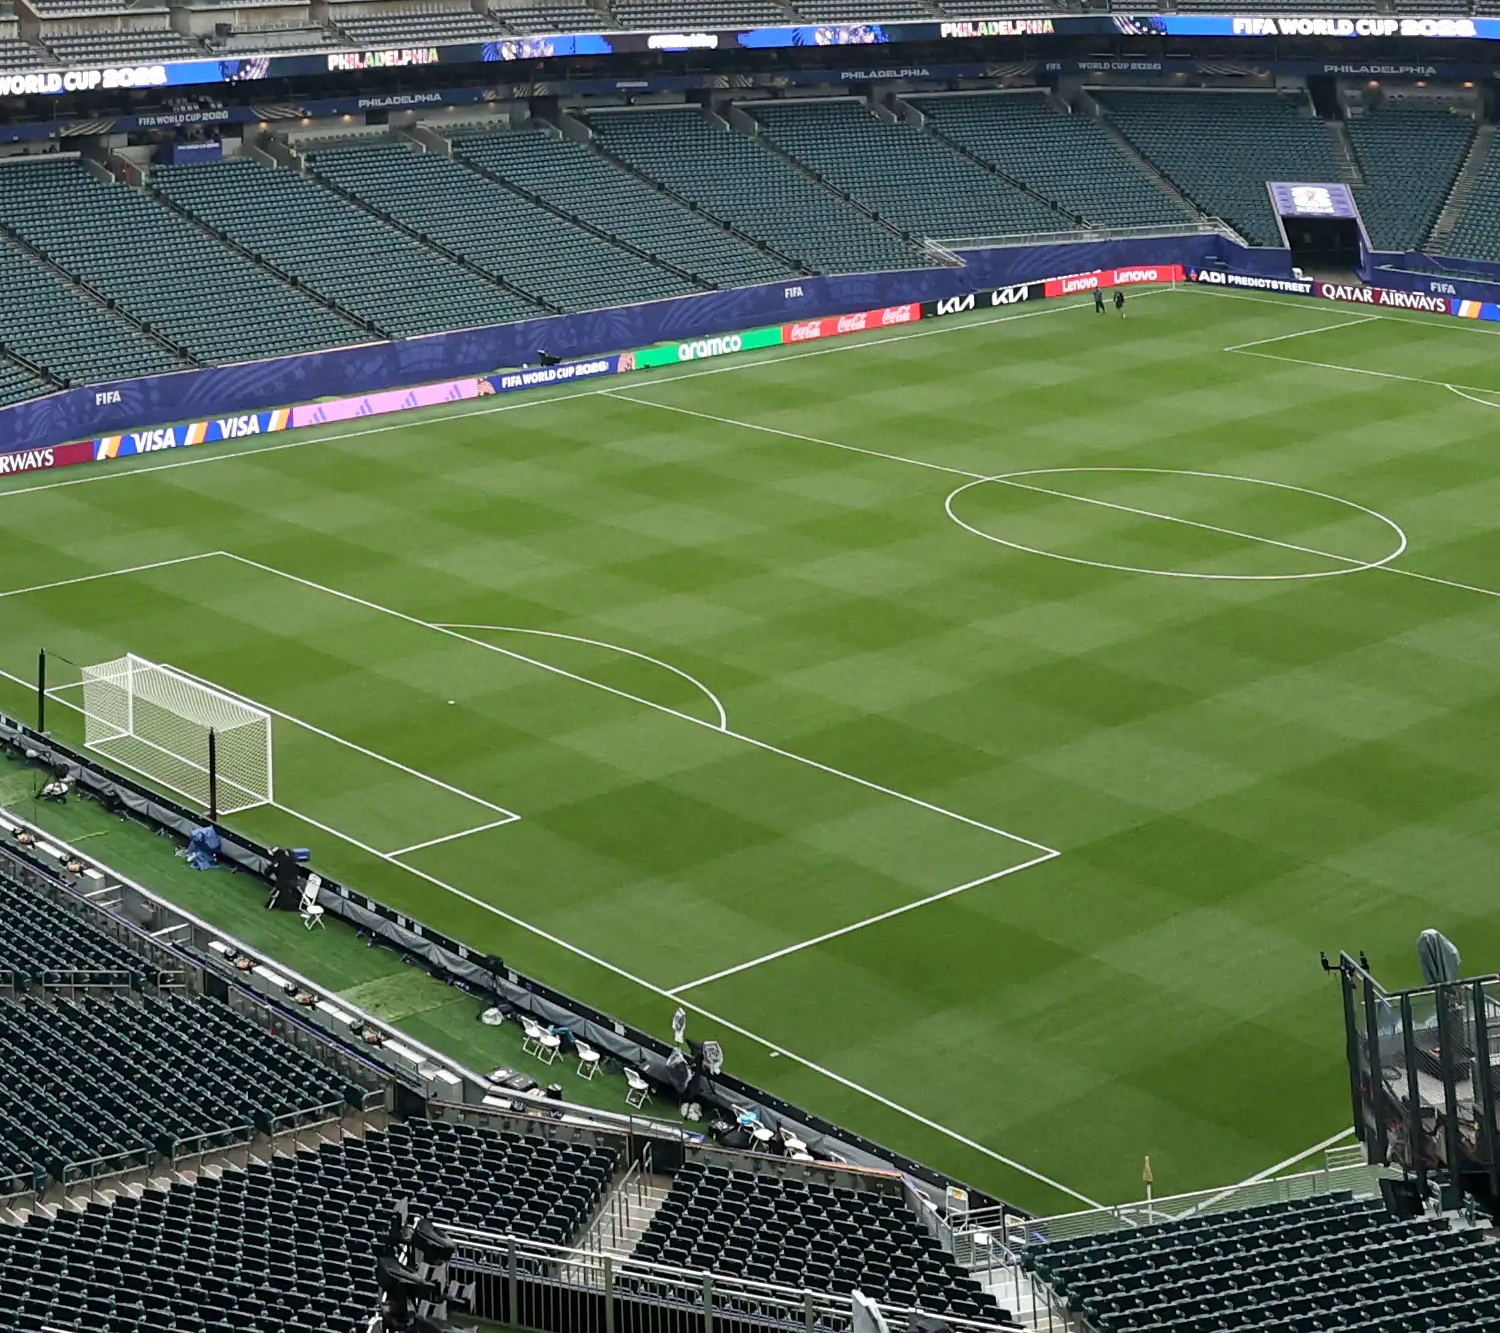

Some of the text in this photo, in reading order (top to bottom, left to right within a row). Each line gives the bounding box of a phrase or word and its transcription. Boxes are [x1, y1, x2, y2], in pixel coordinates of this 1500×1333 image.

[941, 20, 1056, 38] PHILADELPHIA
[1232, 18, 1278, 35] FIFA
[1278, 18, 1355, 36] WORLD
[1356, 18, 1399, 36] CUP
[328, 47, 440, 71] PHILADELPHIA
[841, 69, 930, 79] PHILADELPHIA
[1324, 65, 1436, 74] PHILADELPHIA
[63, 70, 101, 91] CUP
[358, 93, 442, 108] PHILADELPHIA
[138, 117, 156, 126] FIFA
[156, 114, 184, 124] WORLD
[185, 113, 201, 122] CUP
[1062, 277, 1098, 293] Lenovo
[1113, 270, 1158, 284] Lenovo
[1198, 270, 1312, 293] ADI PREDICTSTREET
[784, 286, 804, 299] FIFA
[1430, 281, 1456, 295] FIFA
[1322, 283, 1446, 312] QATAR AIRWAYS
[678, 334, 742, 361] aramco
[502, 375, 522, 389] FIFA
[522, 370, 556, 385] WORLD
[556, 367, 575, 379] CUP
[95, 390, 122, 406] FIFA
[216, 414, 260, 440] VISA
[130, 428, 176, 454] VISA
